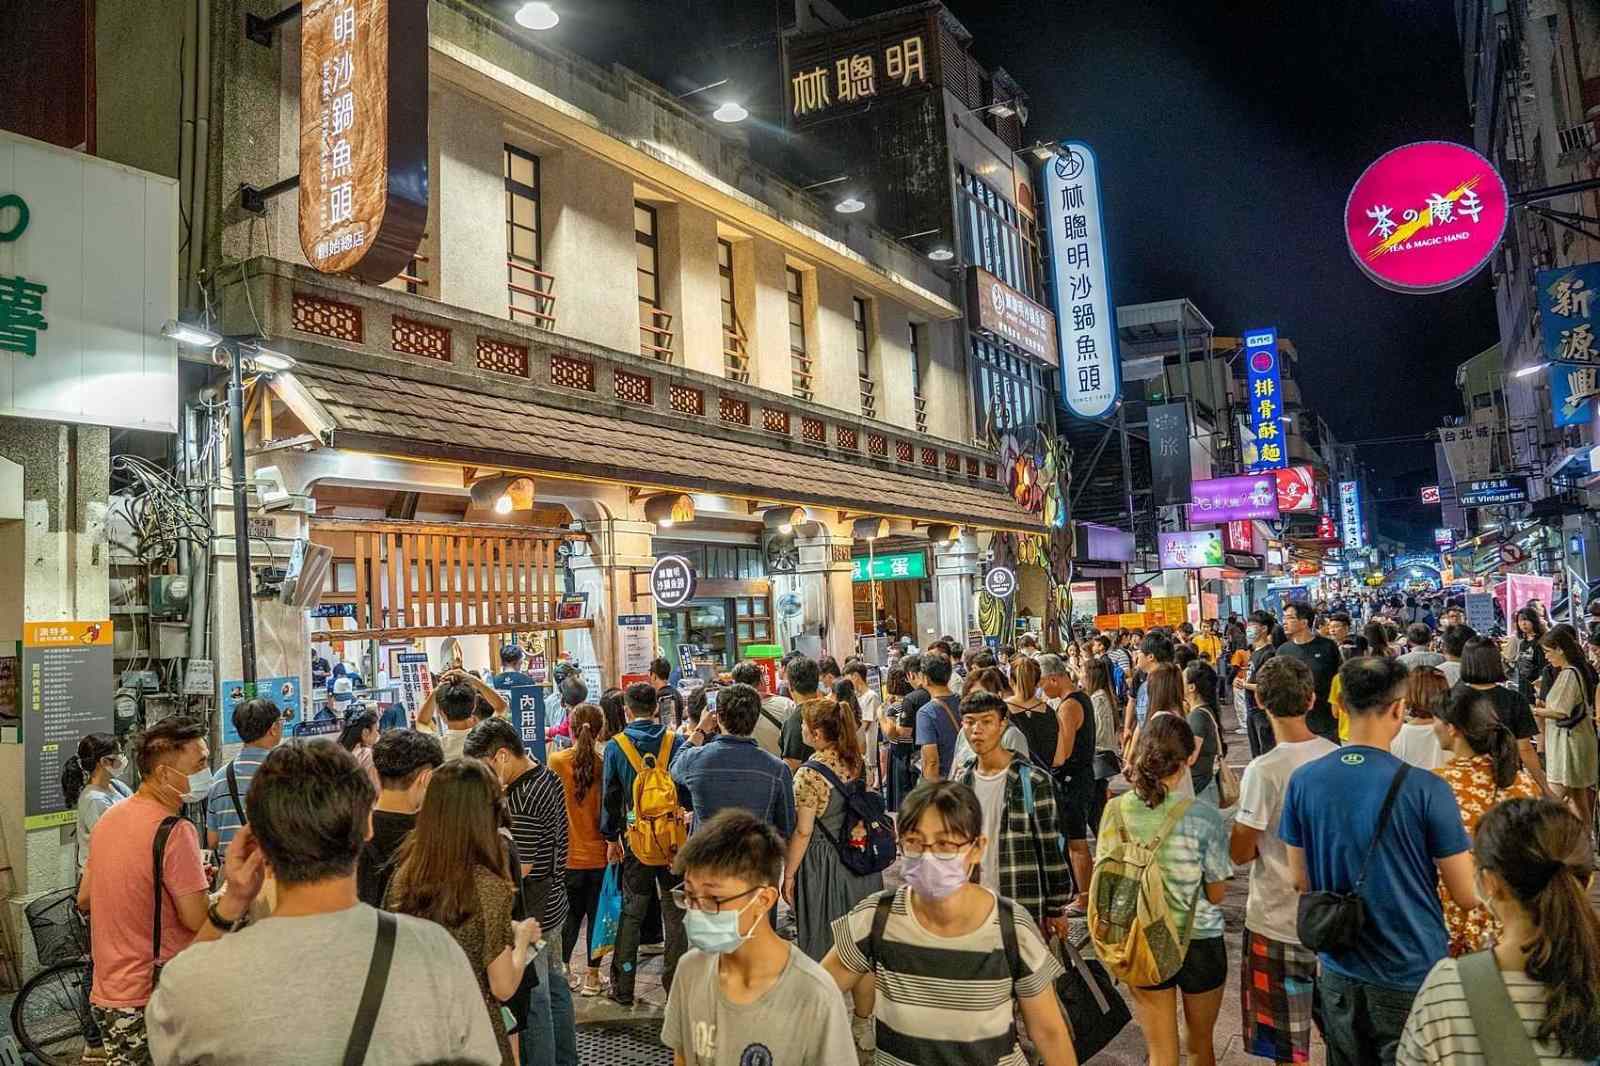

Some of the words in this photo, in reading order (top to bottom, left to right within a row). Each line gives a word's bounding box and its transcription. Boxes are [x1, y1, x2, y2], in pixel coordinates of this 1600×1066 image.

[792, 36, 926, 117] 林聰明
[331, 0, 355, 223] 明沙鍋魚頭
[1366, 187, 1484, 240] 茶の魔手
[1390, 244, 1404, 253] TEA
[1414, 238, 1442, 249] MAGIC
[1444, 232, 1470, 243] HAND
[1061, 183, 1102, 393] 林聰明沙鍋魚頭
[1253, 378, 1281, 463] 排骨酥麵
[1445, 426, 1489, 442] 台北城
[1423, 490, 1439, 500] OK
